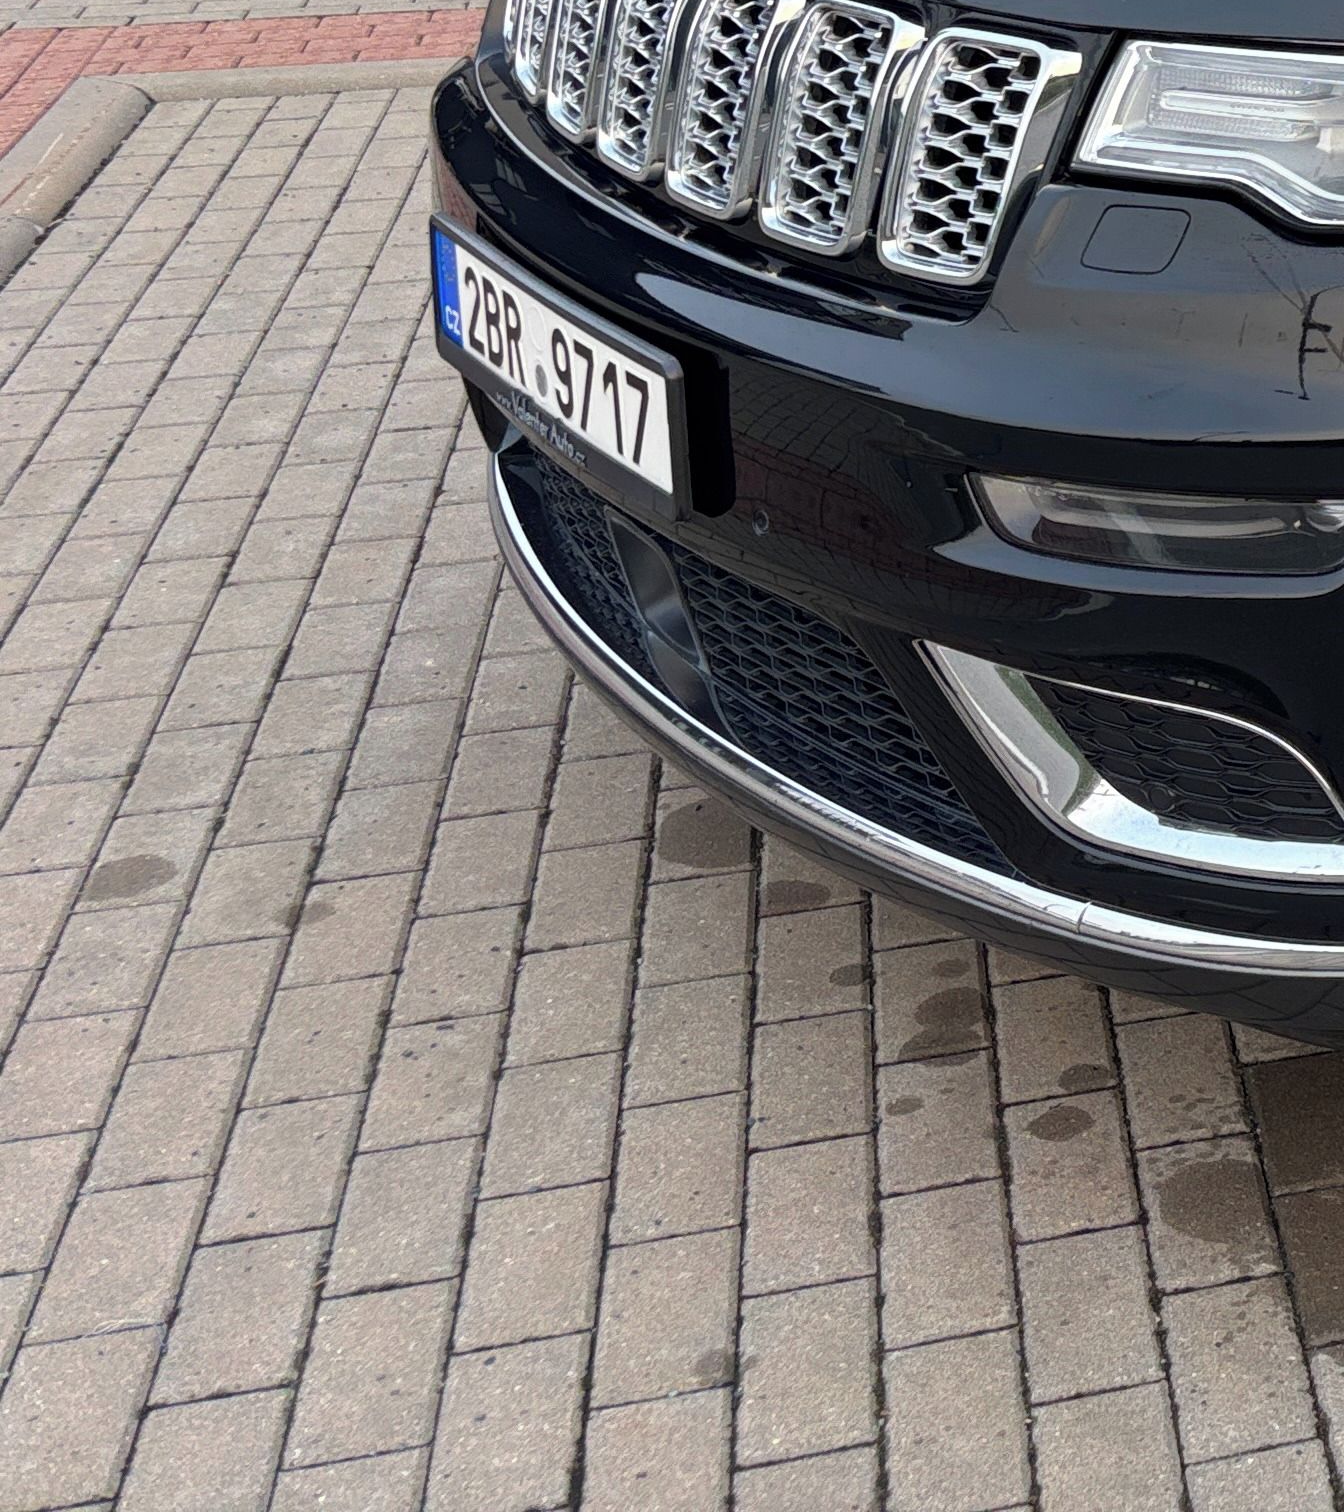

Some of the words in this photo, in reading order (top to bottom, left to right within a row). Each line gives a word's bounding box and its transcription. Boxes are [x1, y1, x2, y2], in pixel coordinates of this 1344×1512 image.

[444, 304, 462, 337] CZ
[463, 264, 529, 390] 2BR
[549, 326, 651, 465] 9717
